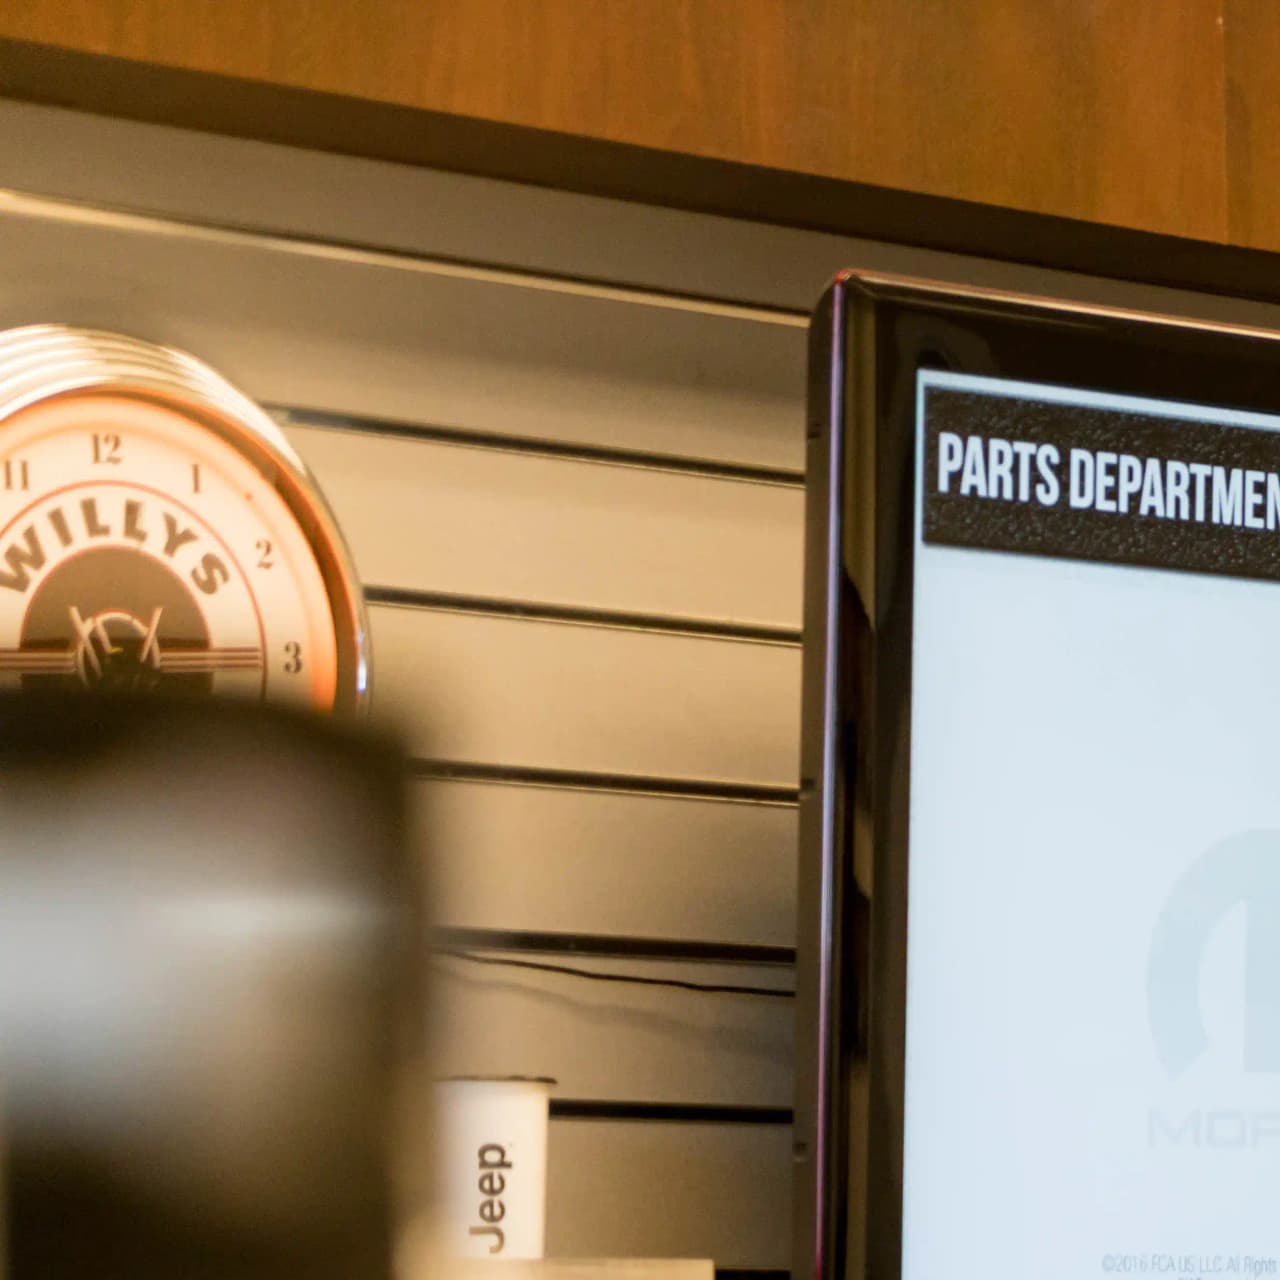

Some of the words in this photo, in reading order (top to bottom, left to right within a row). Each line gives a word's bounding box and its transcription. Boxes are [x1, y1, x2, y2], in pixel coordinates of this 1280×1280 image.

[91, 434, 121, 465] 12
[3, 461, 30, 491] 11
[937, 432, 1060, 508] PARTS
[0, 498, 230, 597] WILLYS
[257, 542, 274, 569] 2
[284, 642, 303, 674] 3
[469, 1143, 512, 1254] Jeep
